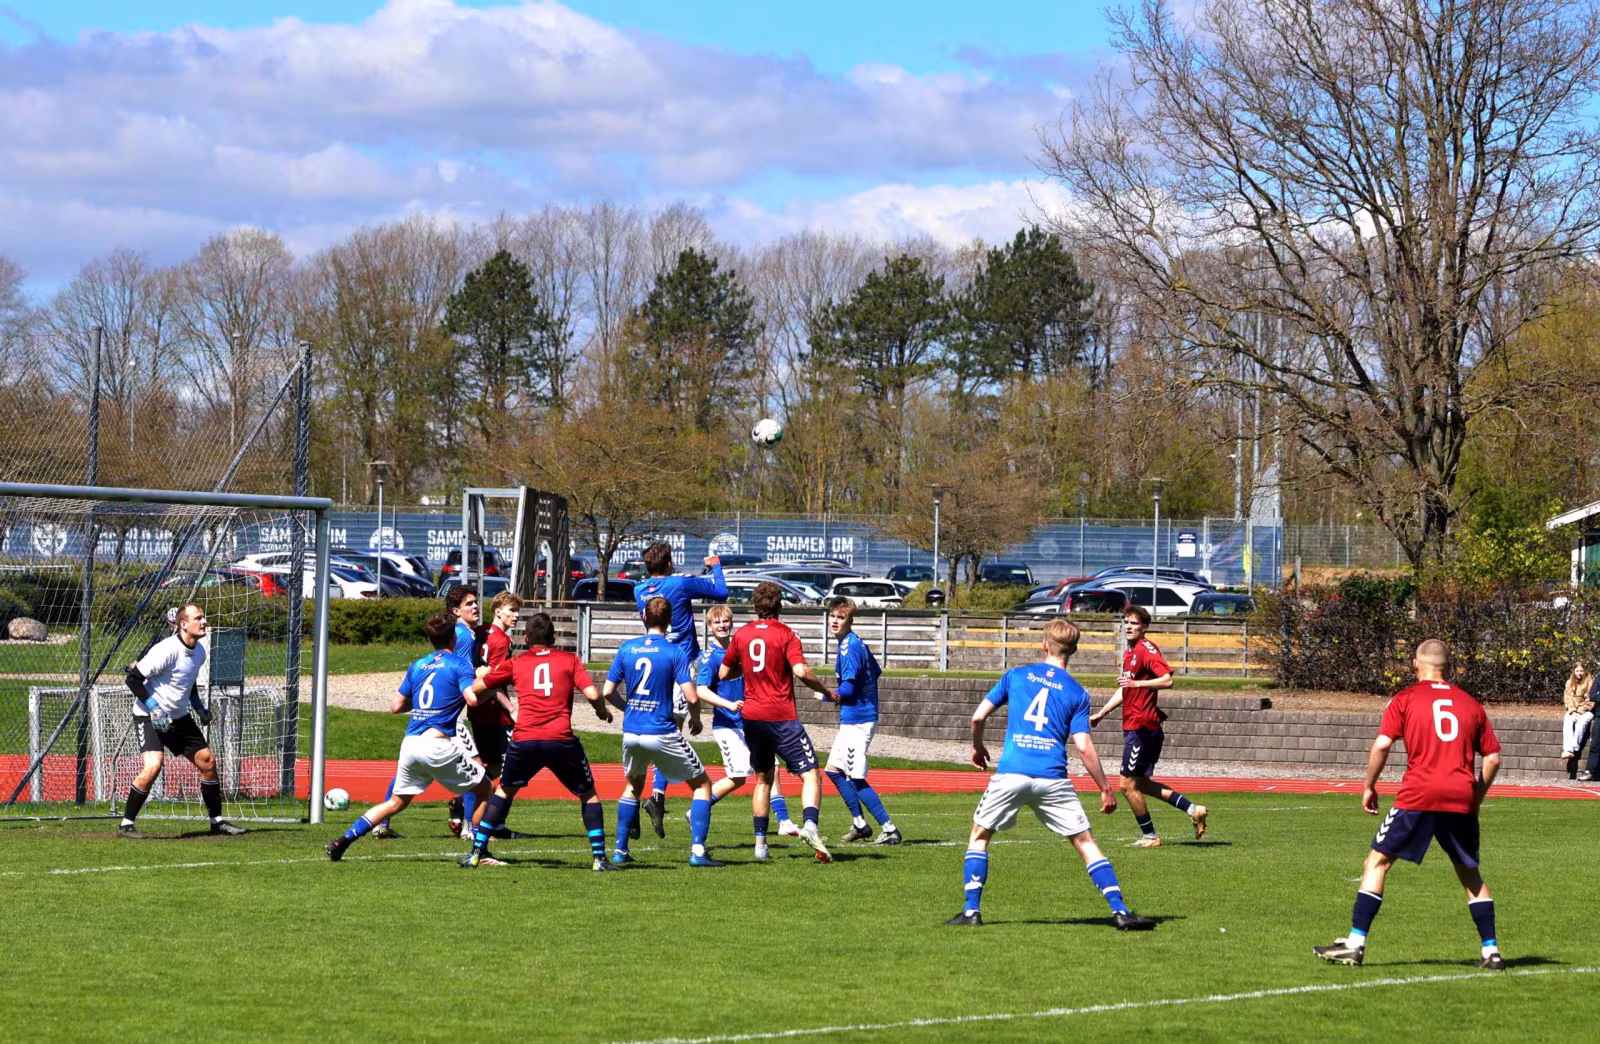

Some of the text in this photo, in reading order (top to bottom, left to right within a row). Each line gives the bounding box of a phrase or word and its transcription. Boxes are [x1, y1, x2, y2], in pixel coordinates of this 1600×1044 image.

[427, 530, 488, 546] SAMN
[767, 535, 854, 553] SAMMEN OM
[631, 646, 660, 655] Sydbank
[749, 638, 766, 673] 9
[418, 671, 437, 709] 6
[533, 662, 553, 697] 4
[635, 657, 652, 696] 2
[1027, 672, 1064, 691] Sydbank
[1023, 687, 1049, 731] 4
[1432, 699, 1459, 742] 6
